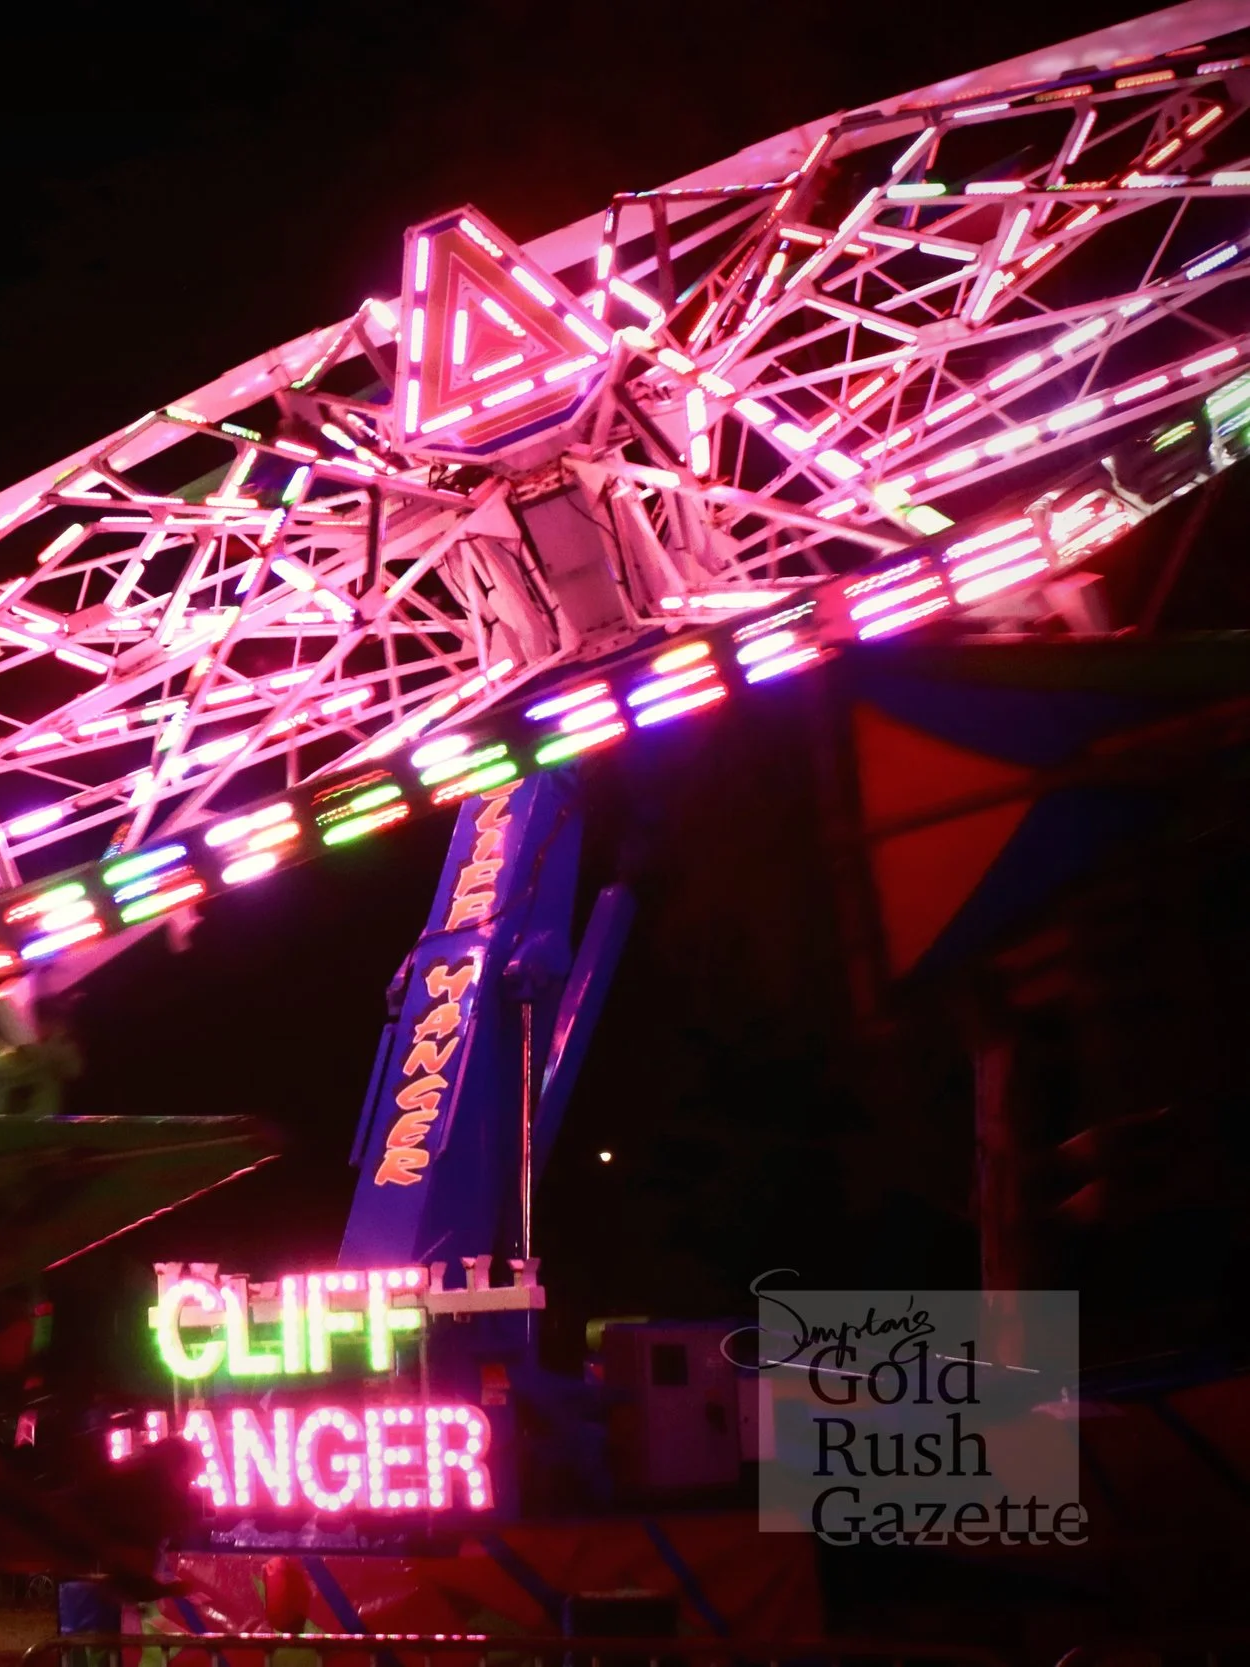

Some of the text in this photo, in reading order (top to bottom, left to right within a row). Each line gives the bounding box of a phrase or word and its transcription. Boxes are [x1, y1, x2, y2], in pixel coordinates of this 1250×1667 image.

[374, 963, 475, 1186] HANGER
[156, 1267, 429, 1380] CLIFF
[110, 1407, 494, 1512] ANGER
